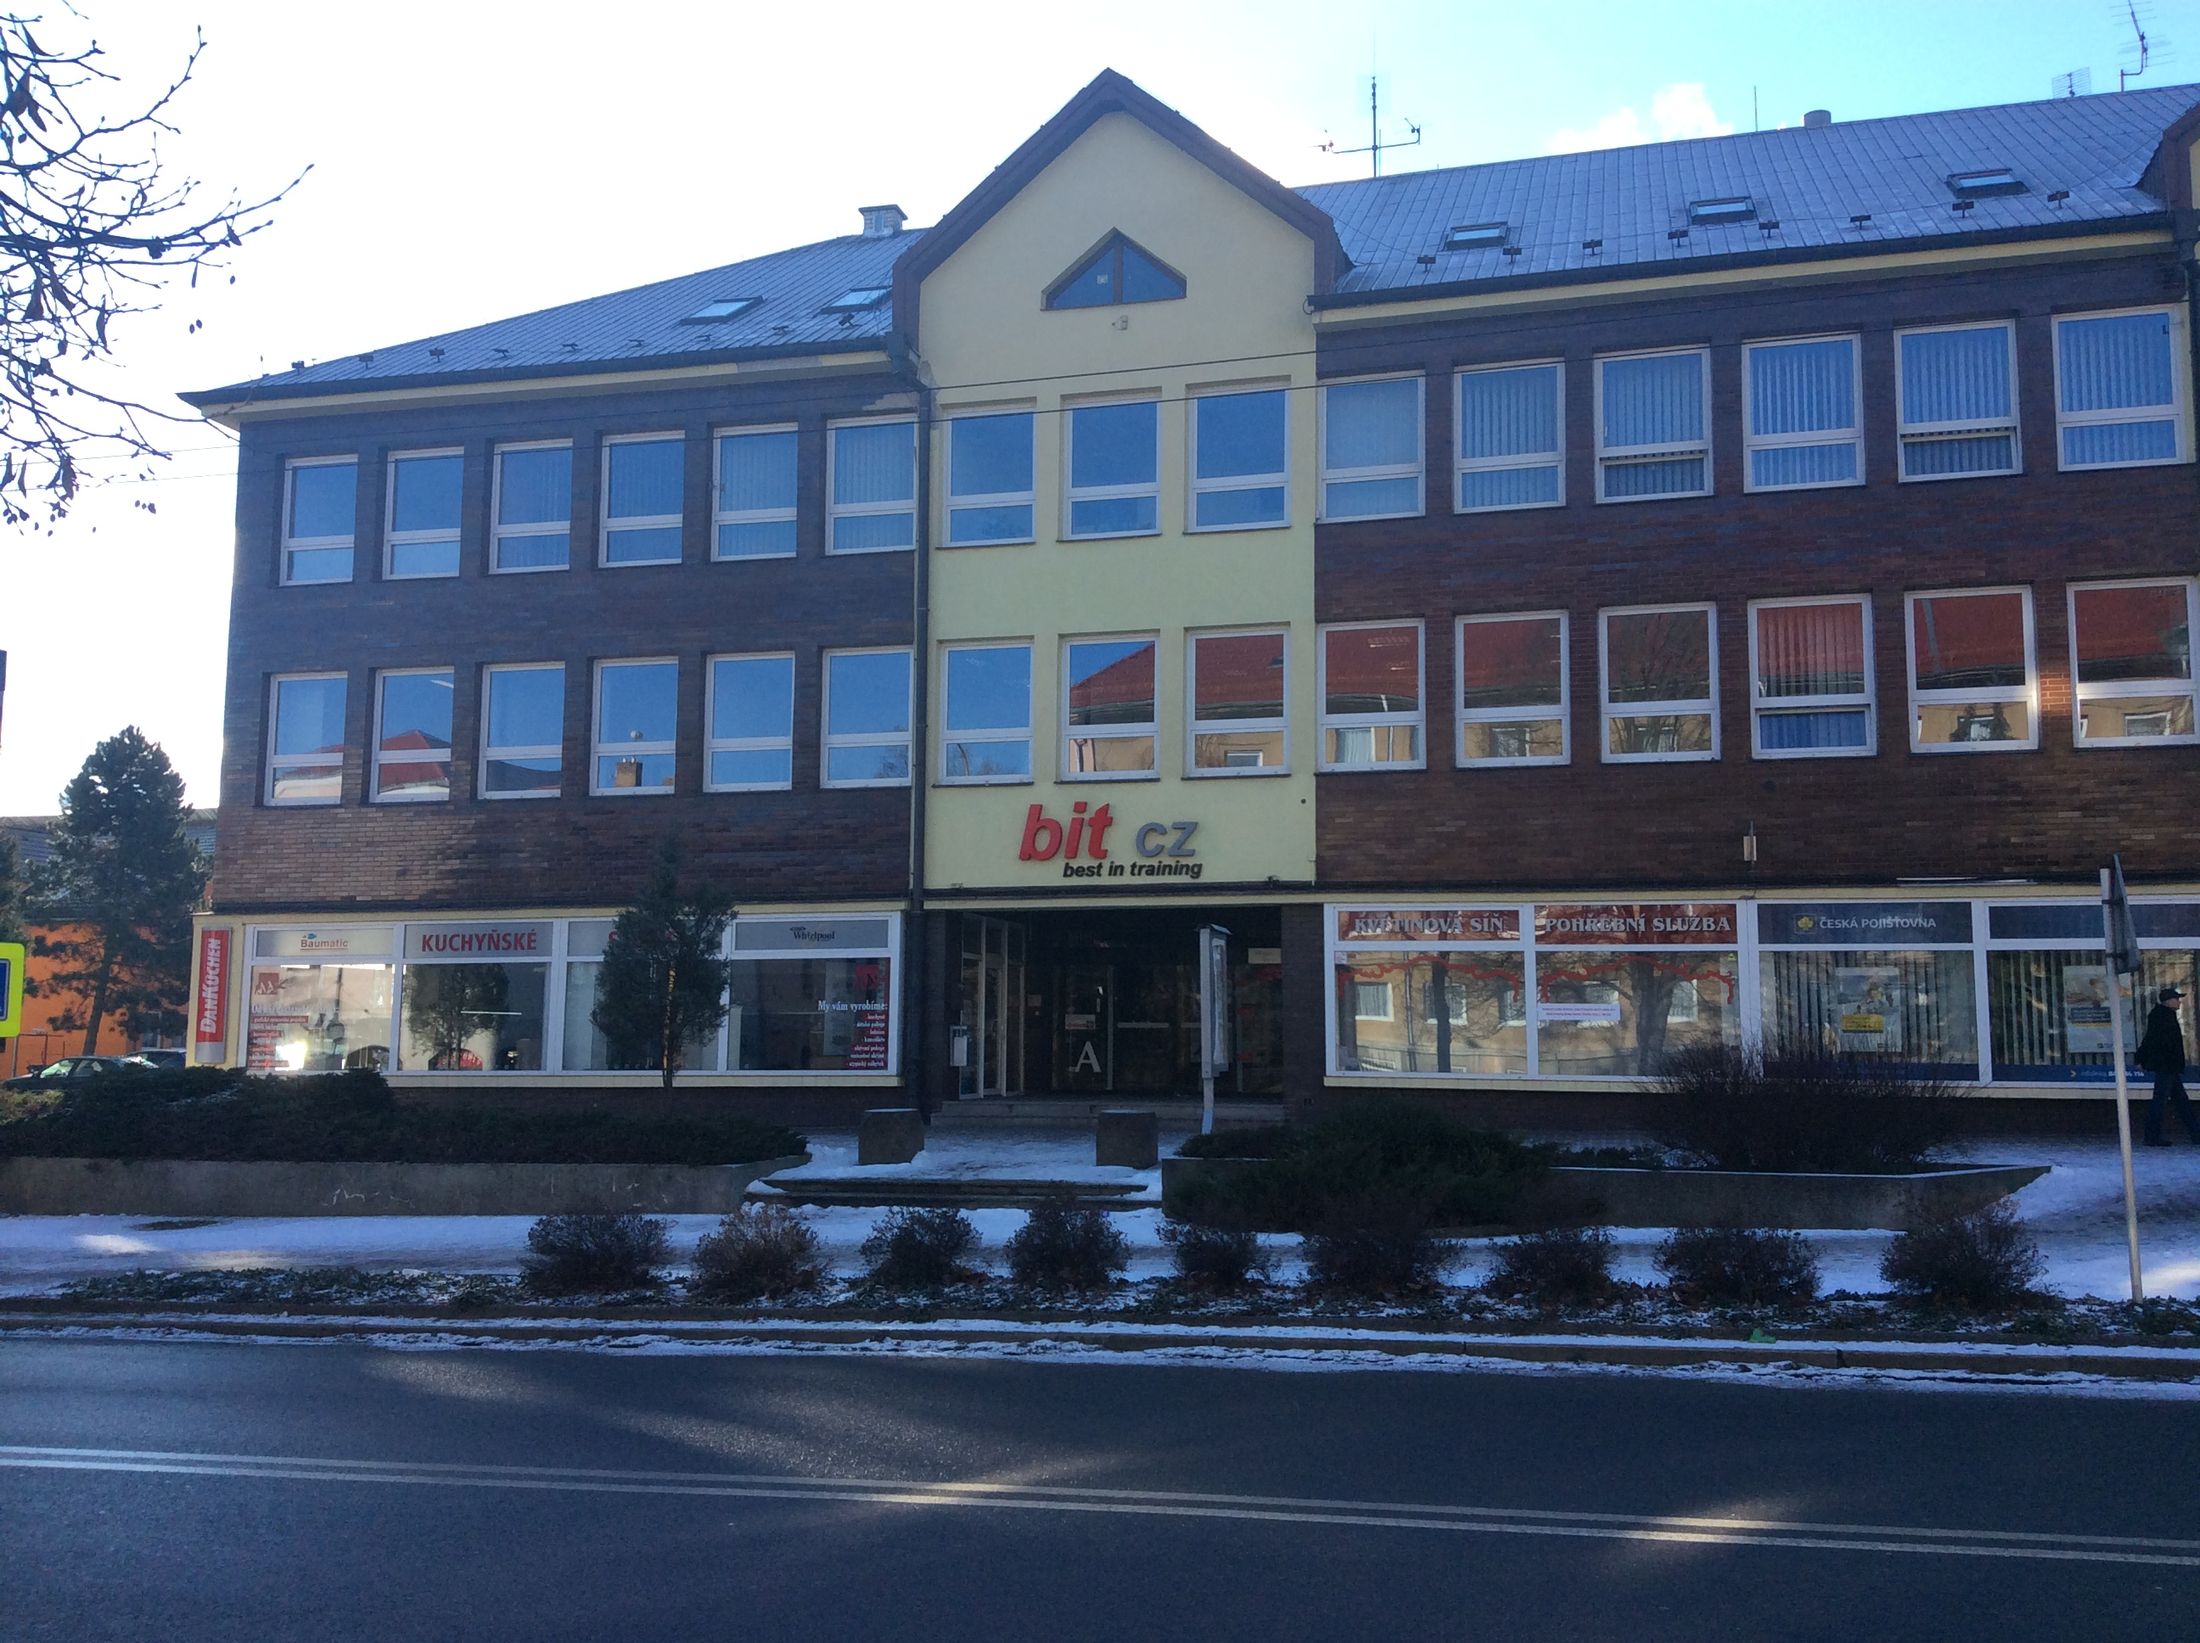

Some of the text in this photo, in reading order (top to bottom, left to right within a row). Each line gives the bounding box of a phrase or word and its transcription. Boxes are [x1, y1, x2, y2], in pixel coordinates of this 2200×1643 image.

[1019, 801, 1199, 861] bit cz
[1063, 860, 1203, 879] best in training
[1544, 912, 1731, 932] POHŘEBNÍ SLUŽBA
[1819, 916, 1858, 929] ČESKÁ
[300, 938, 349, 948] Baumatic
[422, 929, 537, 952] KUCHYŇSKÉ
[817, 1000, 831, 1012] My
[831, 1000, 849, 1010] vám
